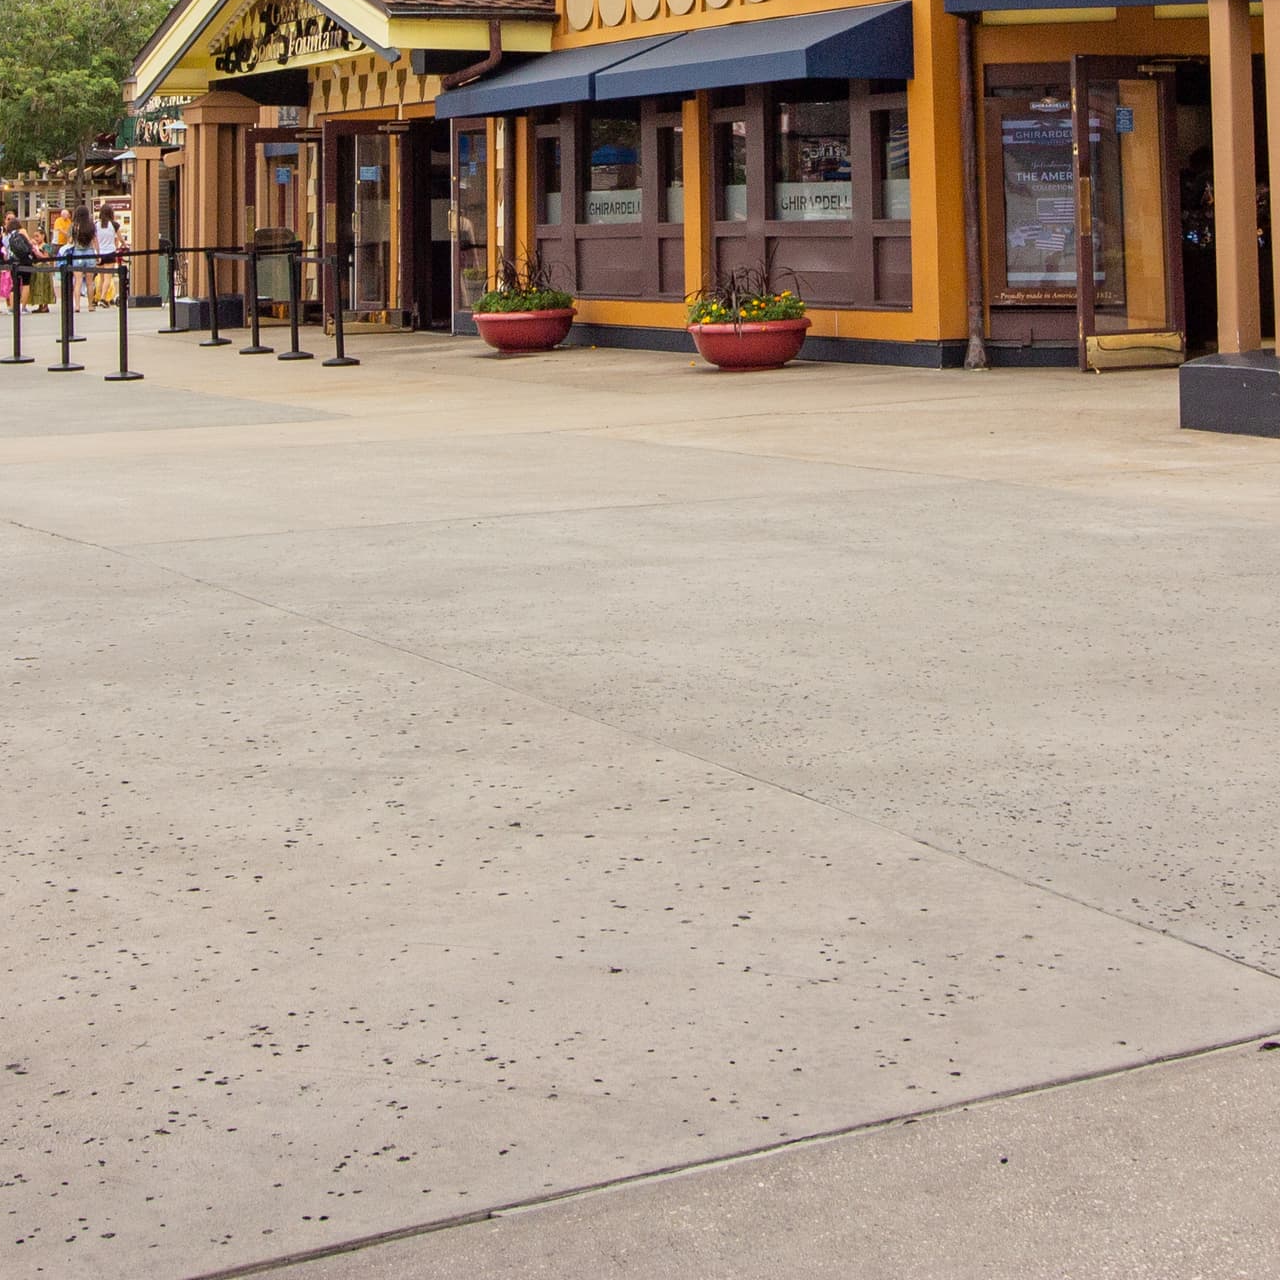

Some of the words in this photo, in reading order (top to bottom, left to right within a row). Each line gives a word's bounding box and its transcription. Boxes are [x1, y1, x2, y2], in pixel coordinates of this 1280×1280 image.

[287, 22, 343, 58] Fountain
[1017, 172, 1038, 181] THE
[1000, 291, 1025, 301] Proudly
